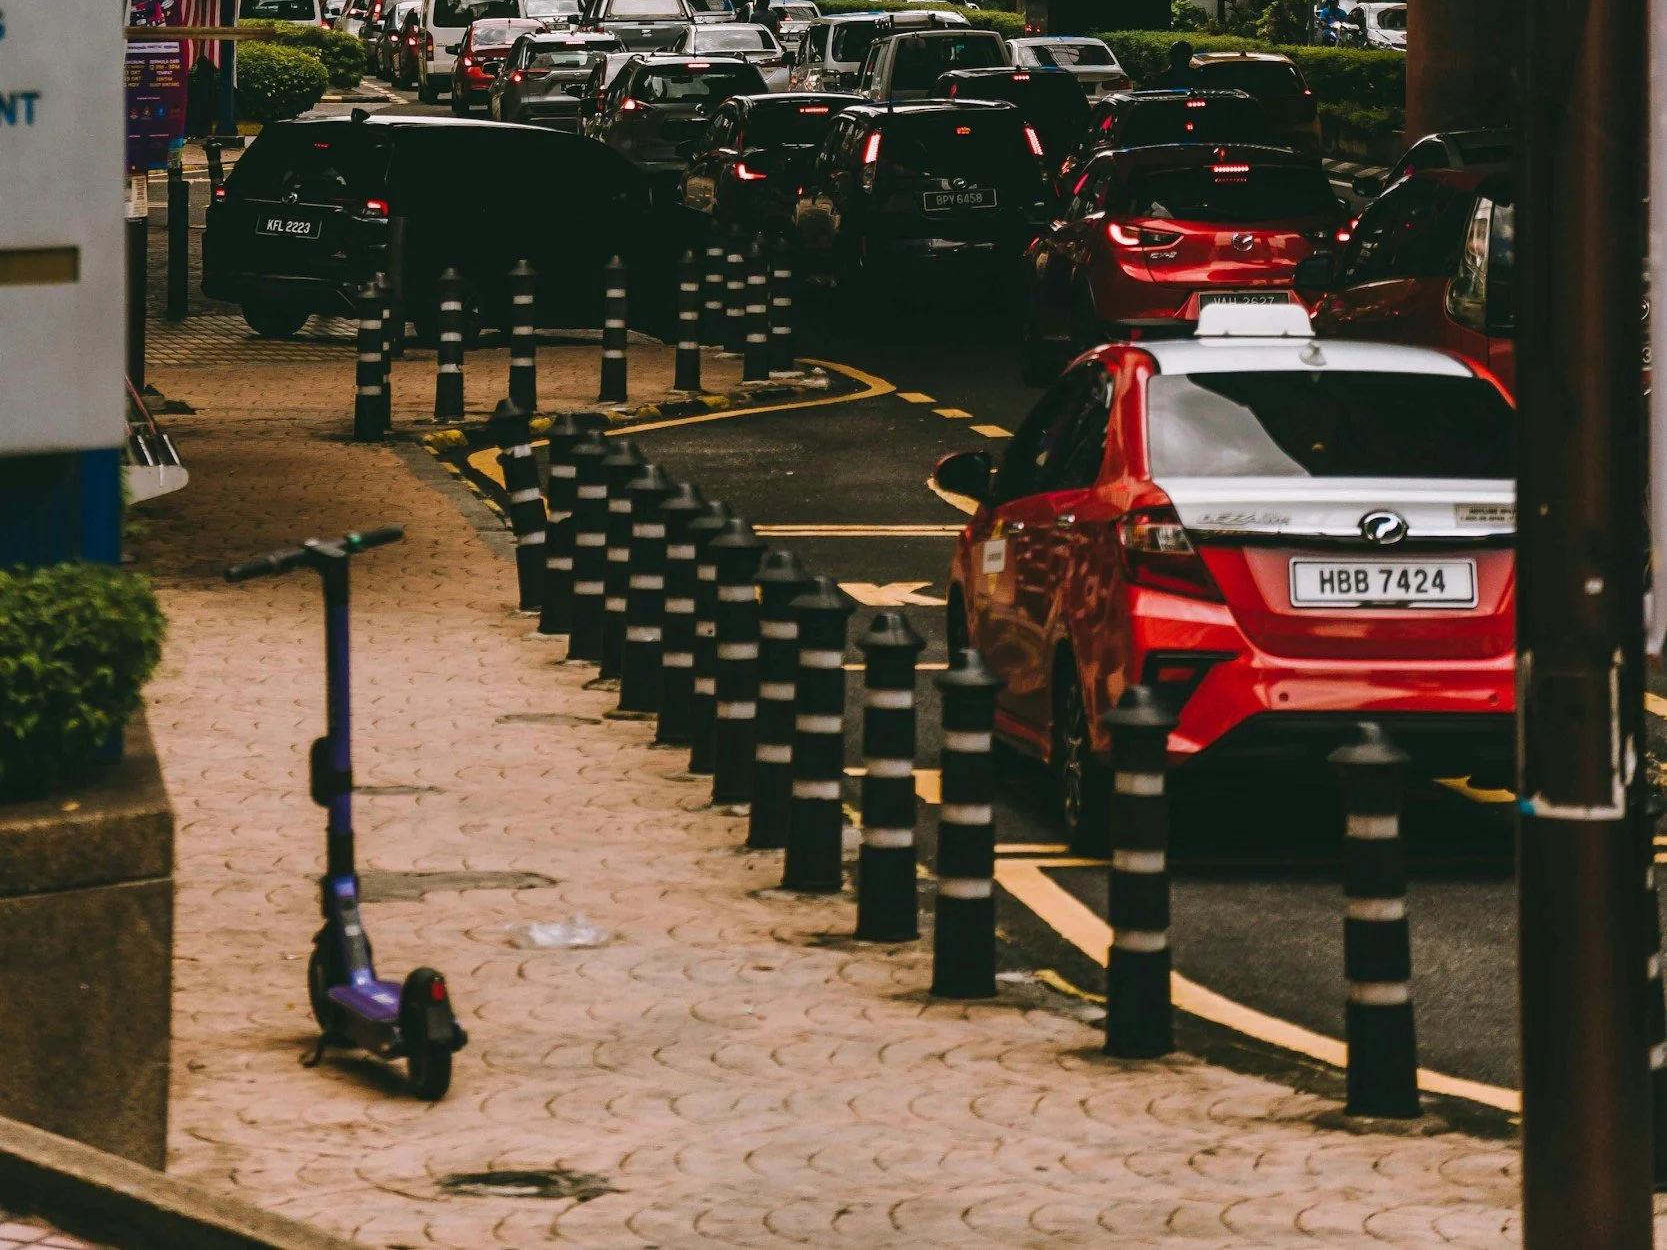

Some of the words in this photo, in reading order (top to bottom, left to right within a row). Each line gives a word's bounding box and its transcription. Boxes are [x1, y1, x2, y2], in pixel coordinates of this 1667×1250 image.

[936, 195, 955, 206] BPY
[956, 193, 983, 205] 6458
[267, 219, 284, 232] KFL
[285, 221, 311, 234] 2223
[1318, 570, 1369, 594] HBB
[1378, 570, 1446, 594] 7424
